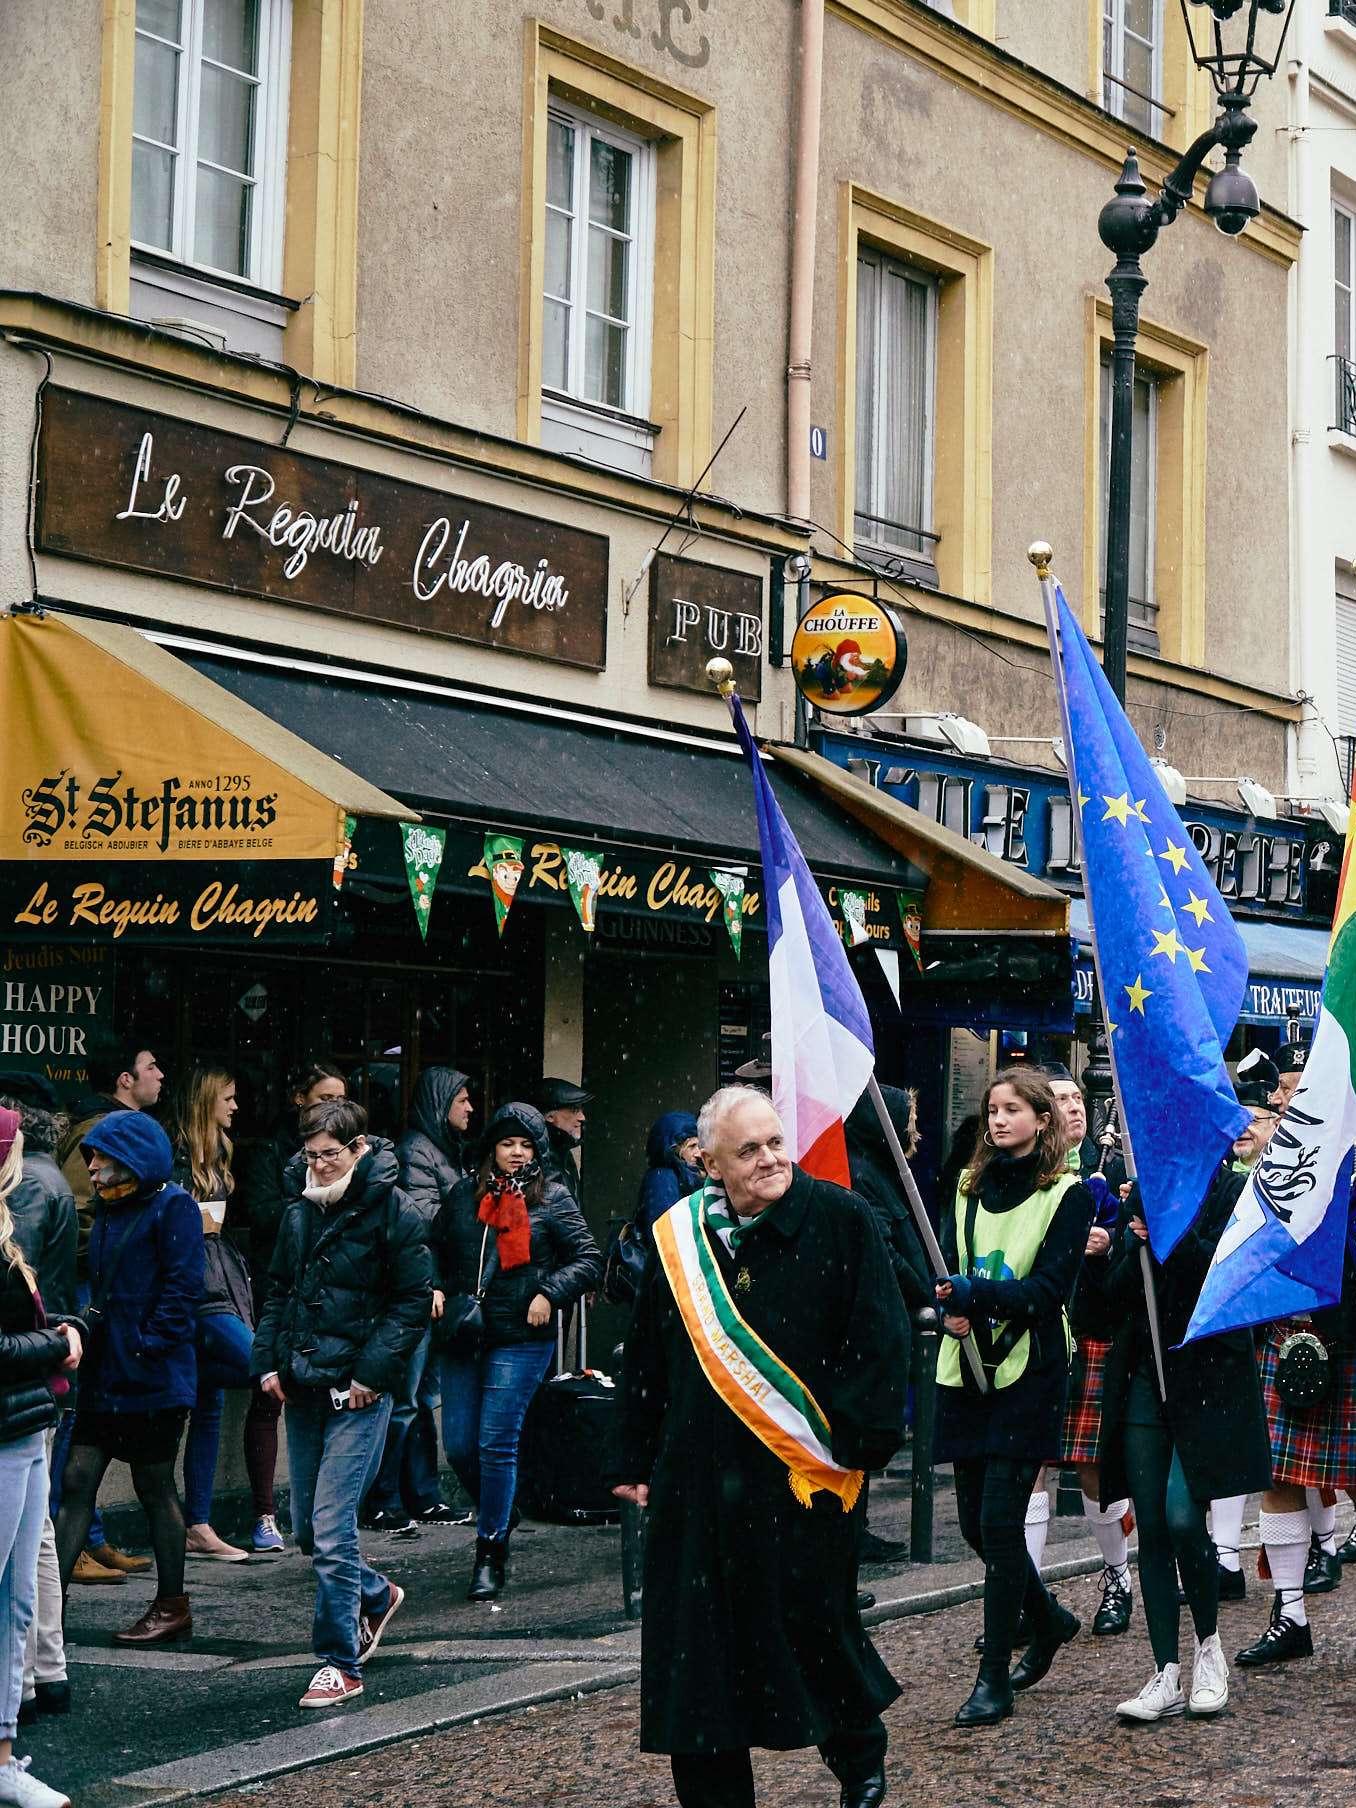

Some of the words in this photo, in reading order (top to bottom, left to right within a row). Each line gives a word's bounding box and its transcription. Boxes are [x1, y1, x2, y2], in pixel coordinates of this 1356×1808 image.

[115, 432, 187, 523] Le
[222, 464, 385, 580] Requin
[413, 517, 569, 630] Chagrin
[671, 598, 763, 657] PUB
[804, 617, 878, 632] CHOUFFE
[834, 609, 845, 617] LA
[188, 780, 213, 789] ANNO
[214, 775, 251, 792] 1295
[82, 769, 278, 853] Stefanus
[64, 840, 103, 850] BELGISCH
[107, 839, 149, 850] ABDIJBIER
[204, 838, 244, 849] D'ABBAYE
[246, 838, 273, 848] BELGE
[14, 881, 58, 925] Le
[69, 882, 181, 938] Requin
[190, 881, 318, 938] Chagrin
[646, 861, 760, 923] Chagn
[3, 982, 103, 1015] HAPPY
[0, 1023, 88, 1056] HOUR
[711, 1327, 773, 1405] MARSHAL
